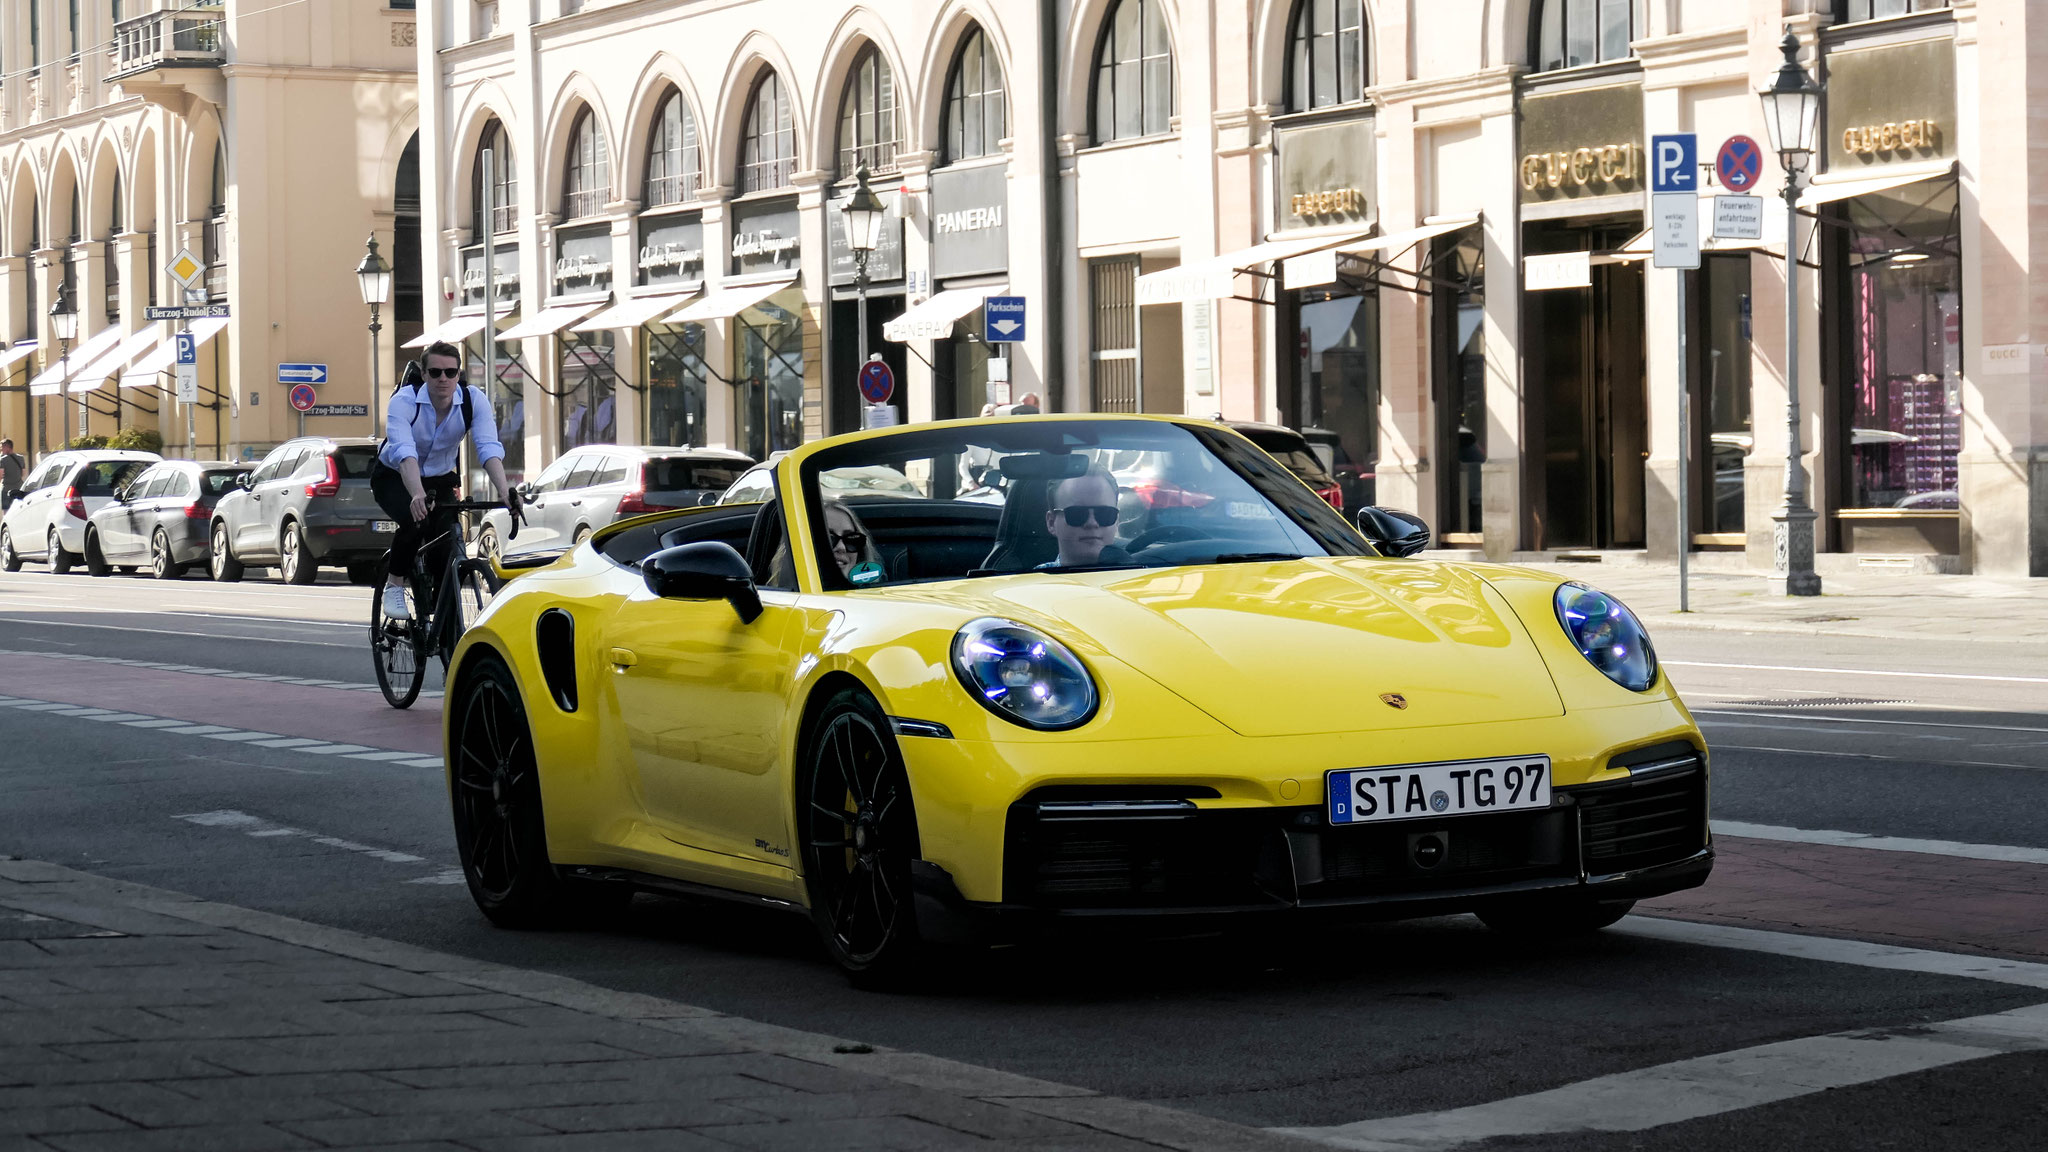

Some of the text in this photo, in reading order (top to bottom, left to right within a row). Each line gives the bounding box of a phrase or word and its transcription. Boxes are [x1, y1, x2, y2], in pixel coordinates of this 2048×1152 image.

[1843, 120, 1934, 154] GUCCI
[1520, 143, 1635, 190] GUCCI
[1659, 141, 1684, 185] P
[1291, 188, 1358, 216] GUCCI
[936, 205, 1002, 234] PANERAI
[152, 306, 227, 318] Herzog-Rudolf-Str.
[988, 302, 1024, 312] Parkschein
[178, 338, 190, 360] P
[861, 562, 870, 572] 4
[1355, 763, 1545, 816] STA TG 97
[1337, 803, 1346, 814] D
